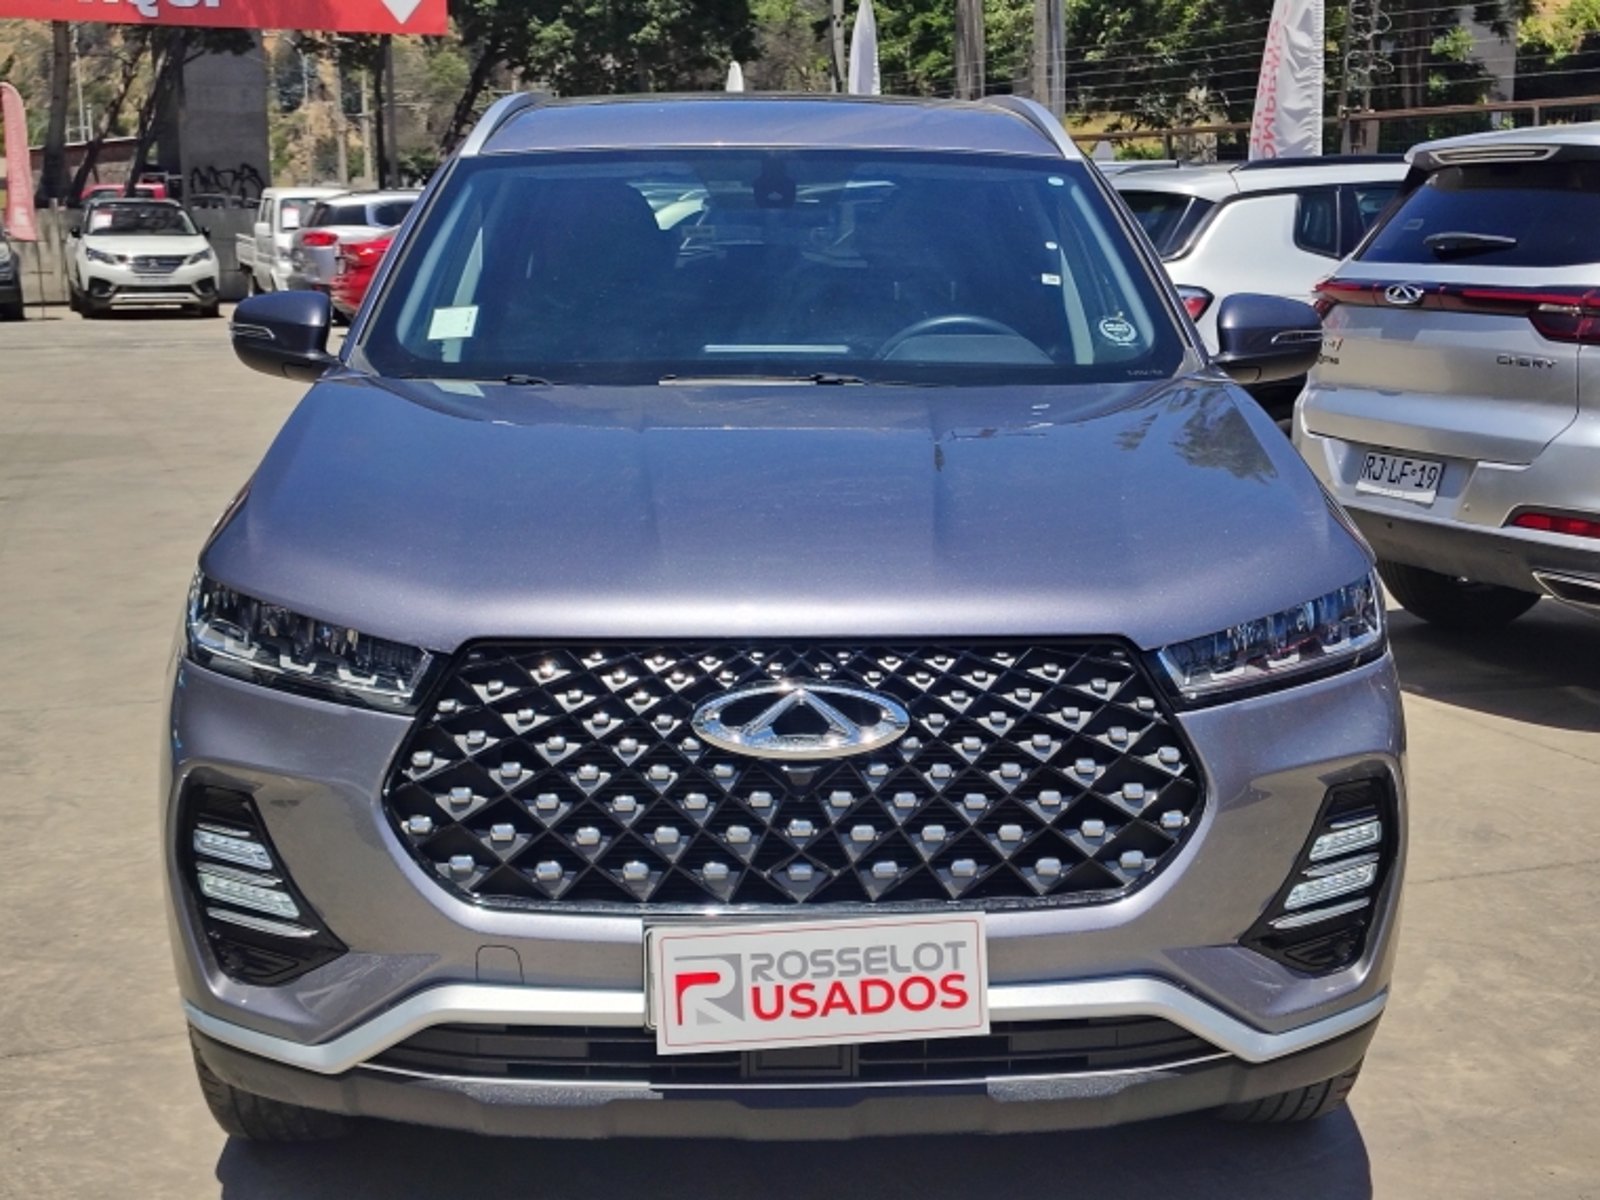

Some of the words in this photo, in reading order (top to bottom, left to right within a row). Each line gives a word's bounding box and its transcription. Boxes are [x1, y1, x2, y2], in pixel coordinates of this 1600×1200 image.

[1496, 354, 1558, 369] CHERY
[749, 940, 967, 983] ROSSELOT
[751, 973, 969, 1022] USADOS
